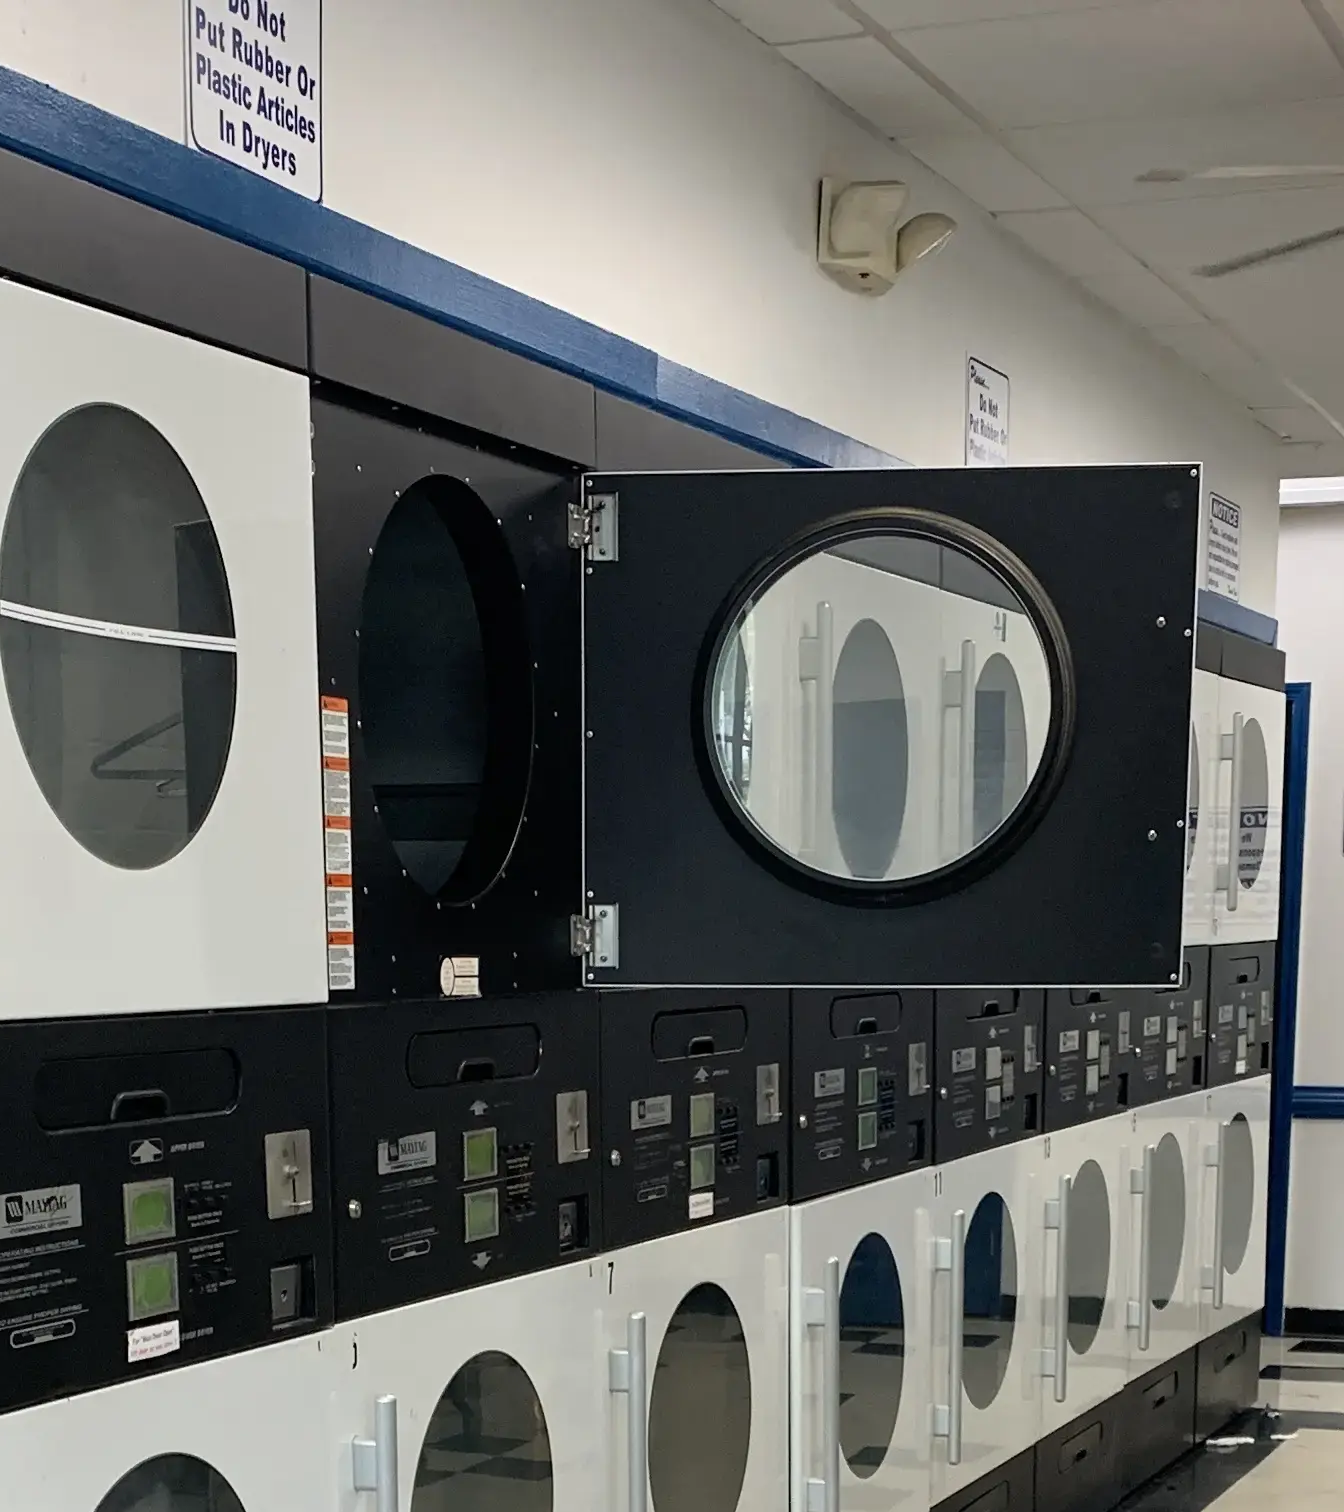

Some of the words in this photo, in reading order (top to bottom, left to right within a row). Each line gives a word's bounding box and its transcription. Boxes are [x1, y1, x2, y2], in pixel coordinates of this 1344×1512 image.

[257, 1, 286, 42] Not
[195, 6, 225, 53] Put
[232, 27, 292, 87] Rubber
[297, 65, 316, 100] Or
[196, 52, 252, 110] Plastic
[257, 86, 316, 144] Articles
[219, 109, 235, 146] In
[242, 121, 297, 176] Dryers
[1212, 501, 1238, 527] NOTICE
[607, 1261, 614, 1294] 7
